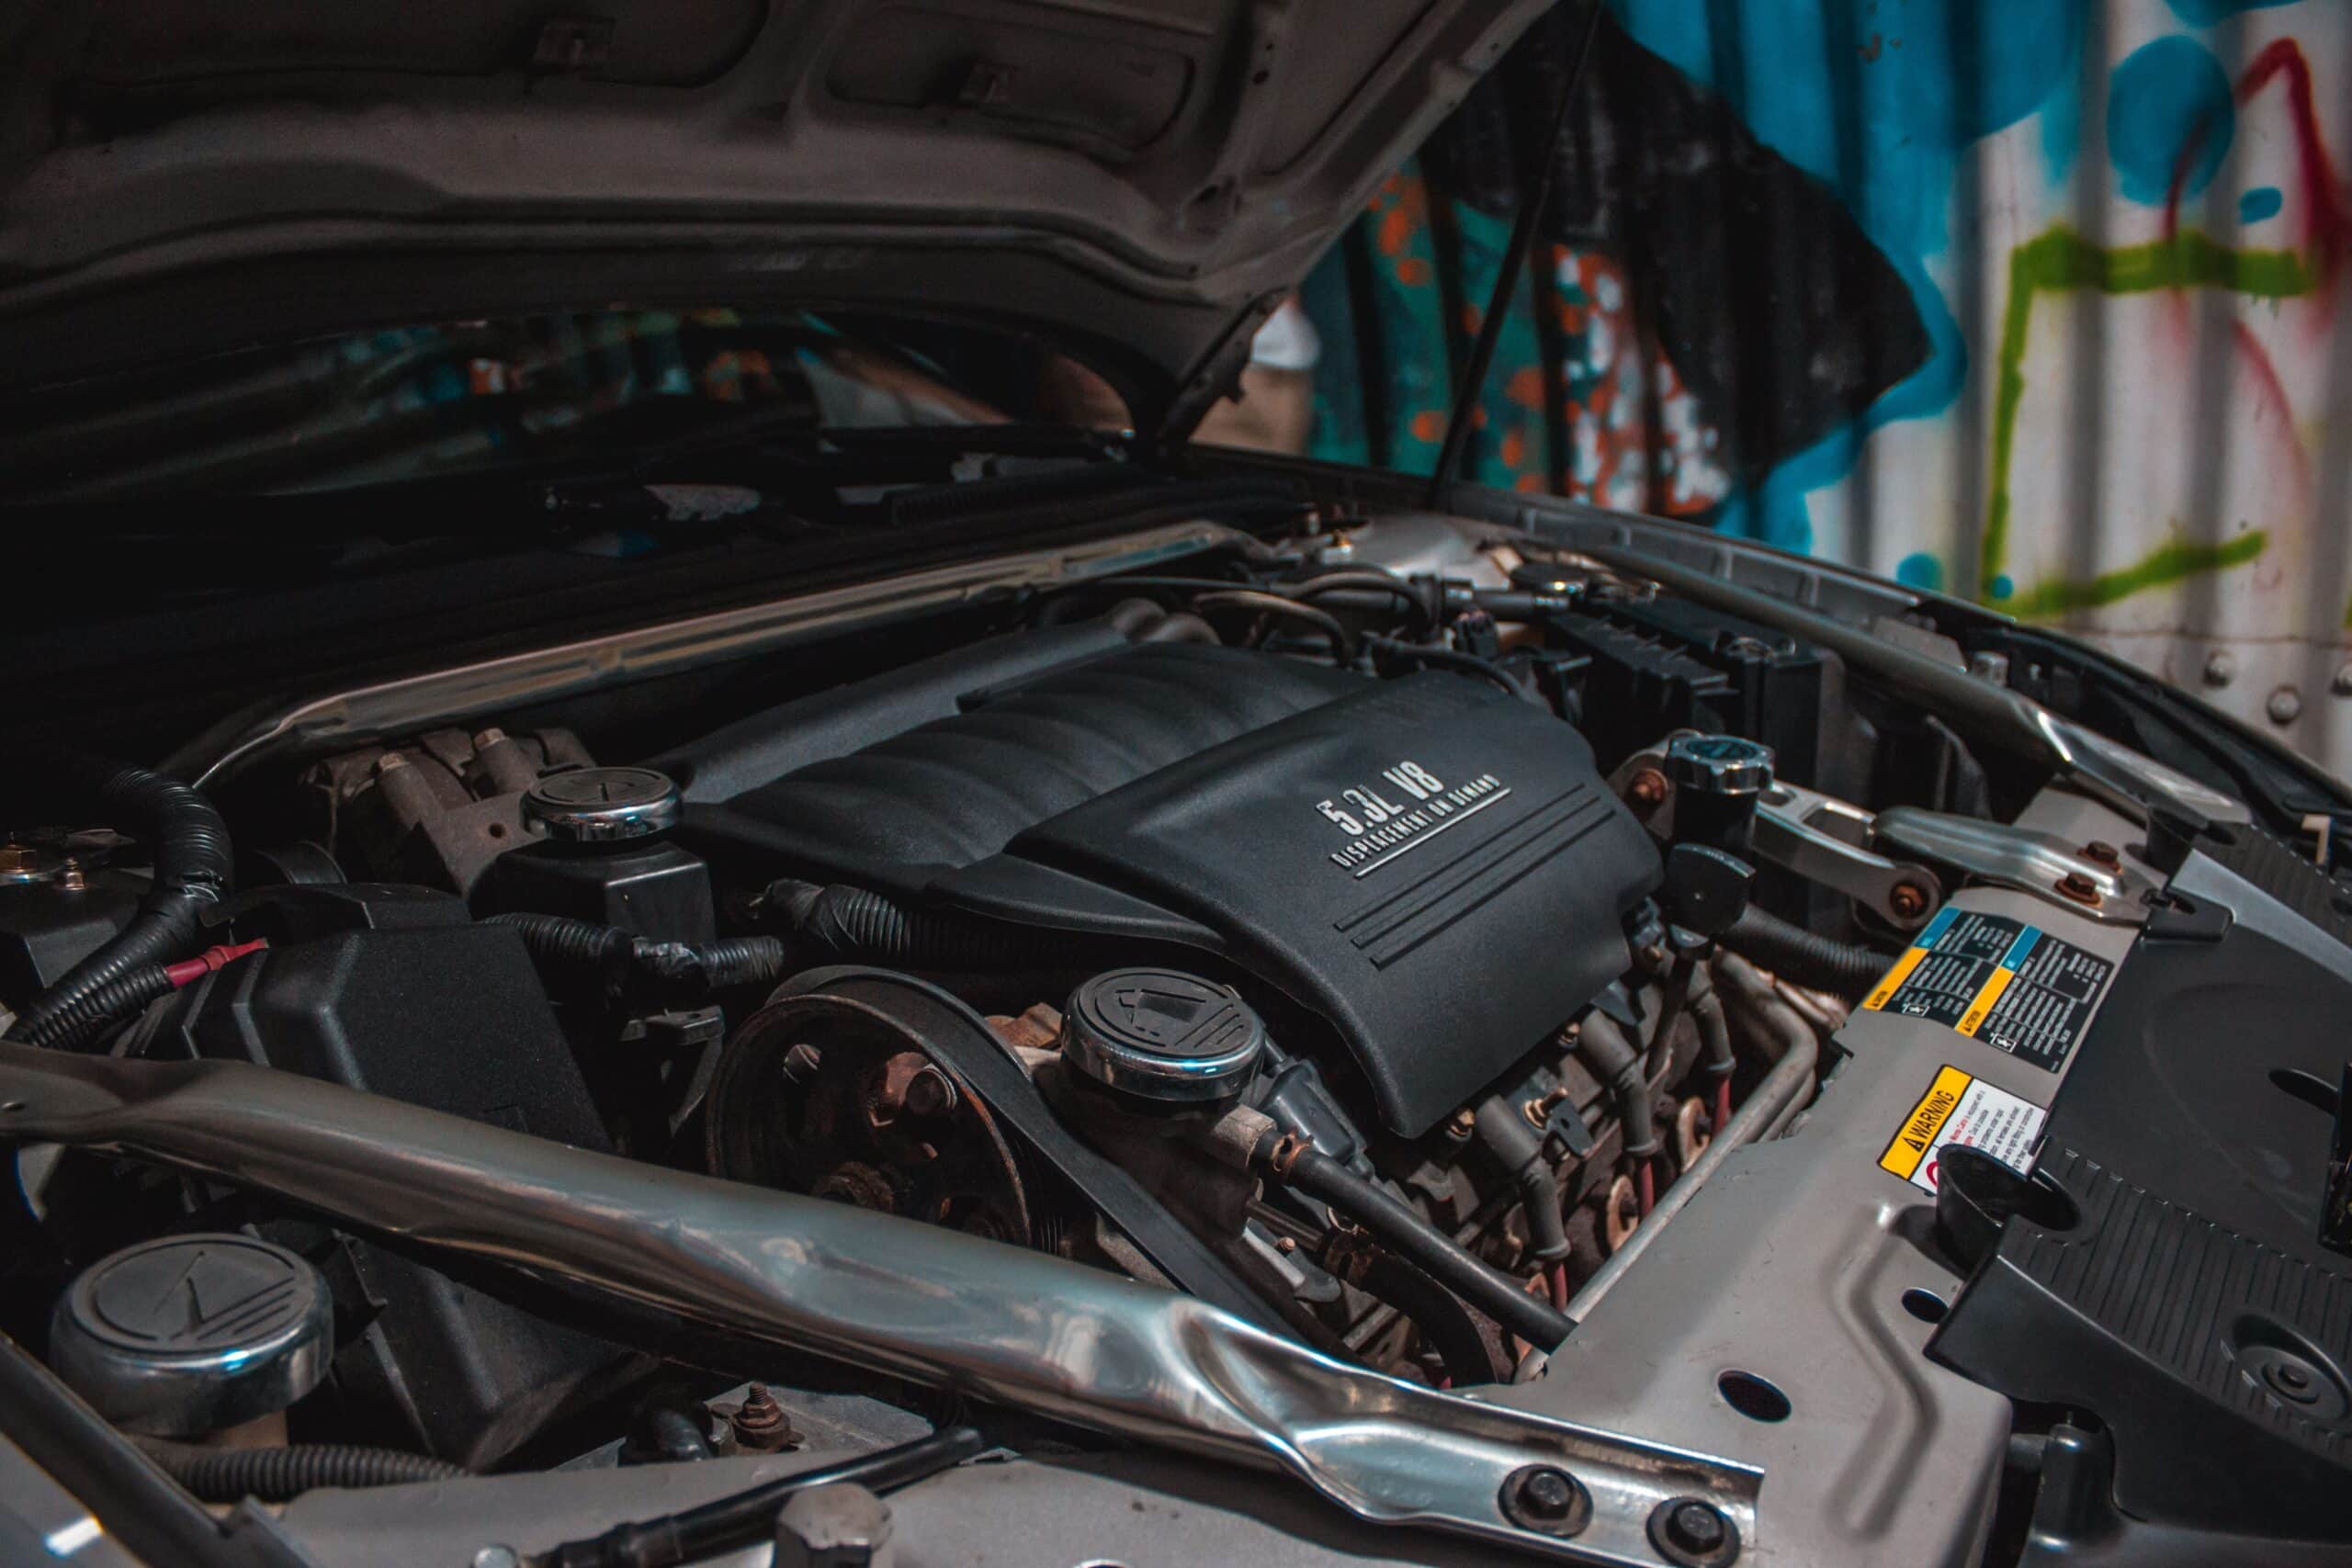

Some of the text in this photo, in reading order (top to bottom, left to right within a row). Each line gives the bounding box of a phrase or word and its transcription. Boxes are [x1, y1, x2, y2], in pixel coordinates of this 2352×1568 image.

[1316, 761, 1444, 836] 5.3L V8
[1330, 773, 1501, 869] DISPLACEMENT ON DEMAND
[1908, 1090, 1955, 1140] WARNING
